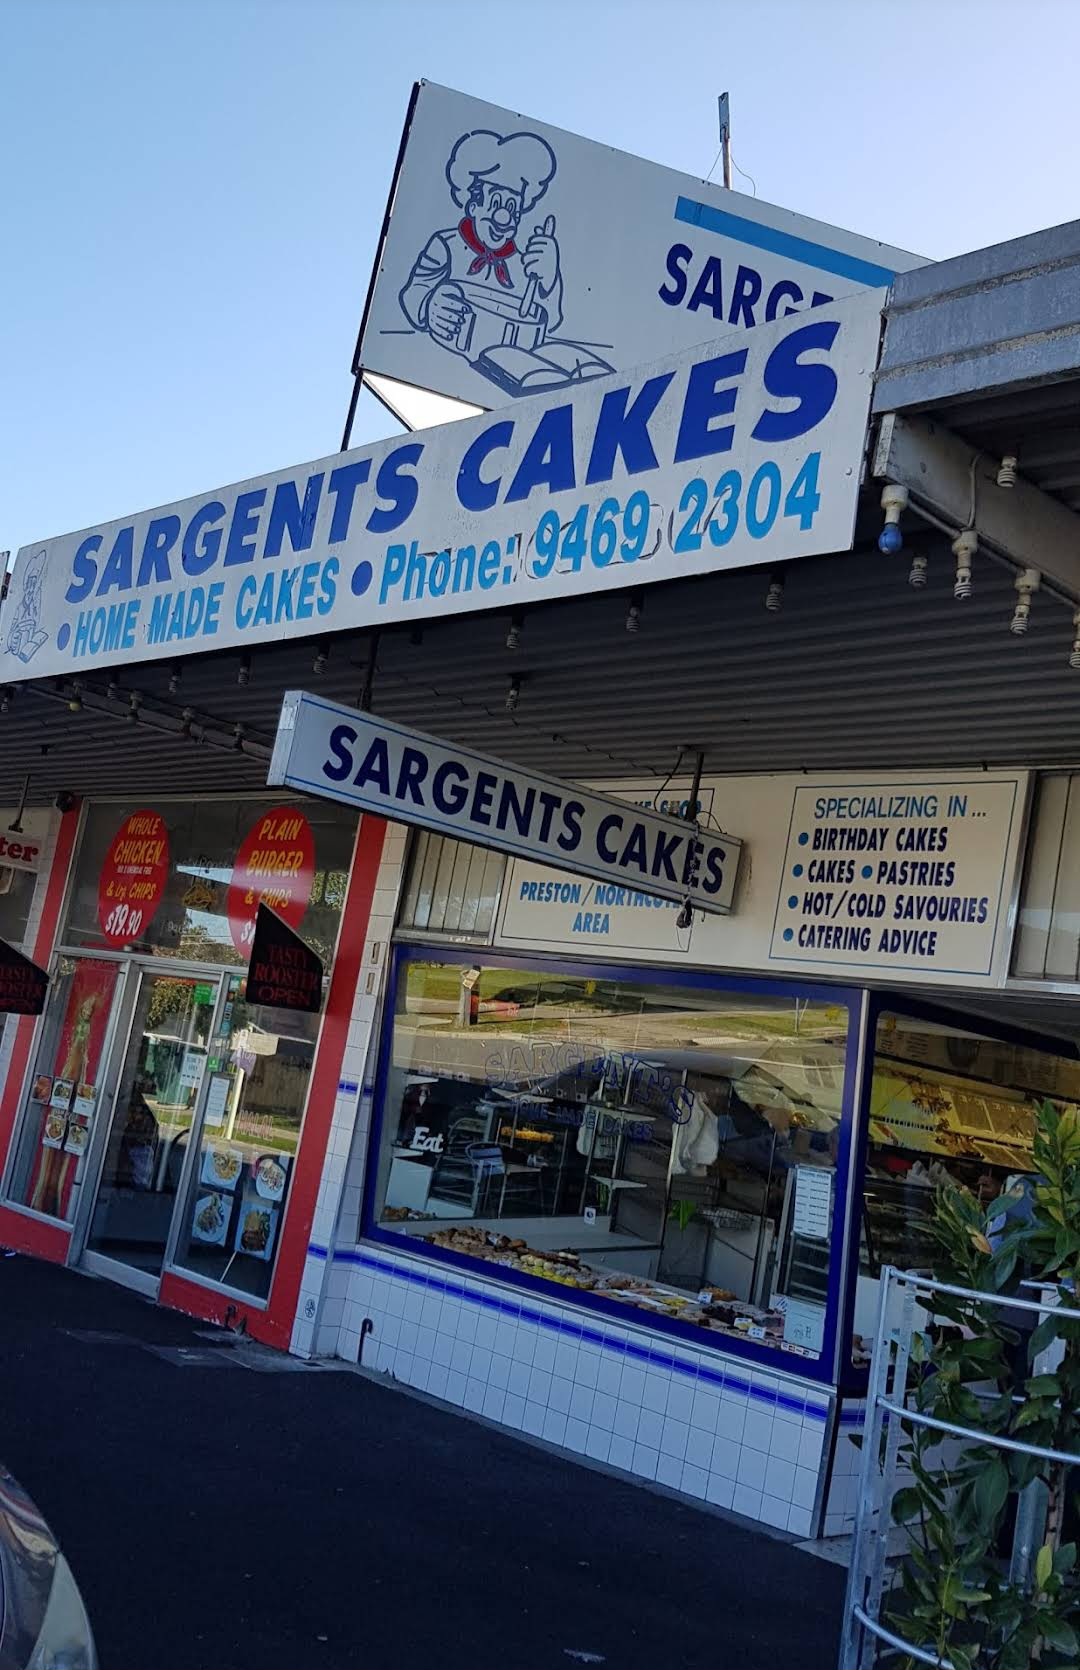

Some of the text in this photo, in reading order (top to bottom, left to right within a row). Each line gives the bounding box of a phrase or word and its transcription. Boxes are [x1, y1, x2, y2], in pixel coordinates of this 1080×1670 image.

[658, 243, 834, 329] SARG
[65, 321, 841, 604] SARGENTS CAKES
[73, 452, 821, 657] HOME MADE CAKES Phone: 9469 2304
[323, 724, 727, 895] SARGENTS CAKES
[814, 795, 938, 819] SPECIALIZING
[127, 817, 161, 836] WHOLE
[258, 819, 304, 841] PLAIN
[812, 826, 948, 851] BIRTHDAY CAKES
[114, 840, 165, 865] CHICKEN
[246, 850, 304, 878] BURGER
[808, 859, 956, 887] CAKES PASTRIES
[128, 882, 157, 900] CHIPS
[260, 887, 292, 909] CHIPS
[105, 904, 143, 936] $19.90
[572, 911, 610, 934] AREA
[893, 895, 989, 924] SAVOURIES
[798, 924, 937, 956] CATERING ADVICE
[409, 1126, 444, 1153] Eat
